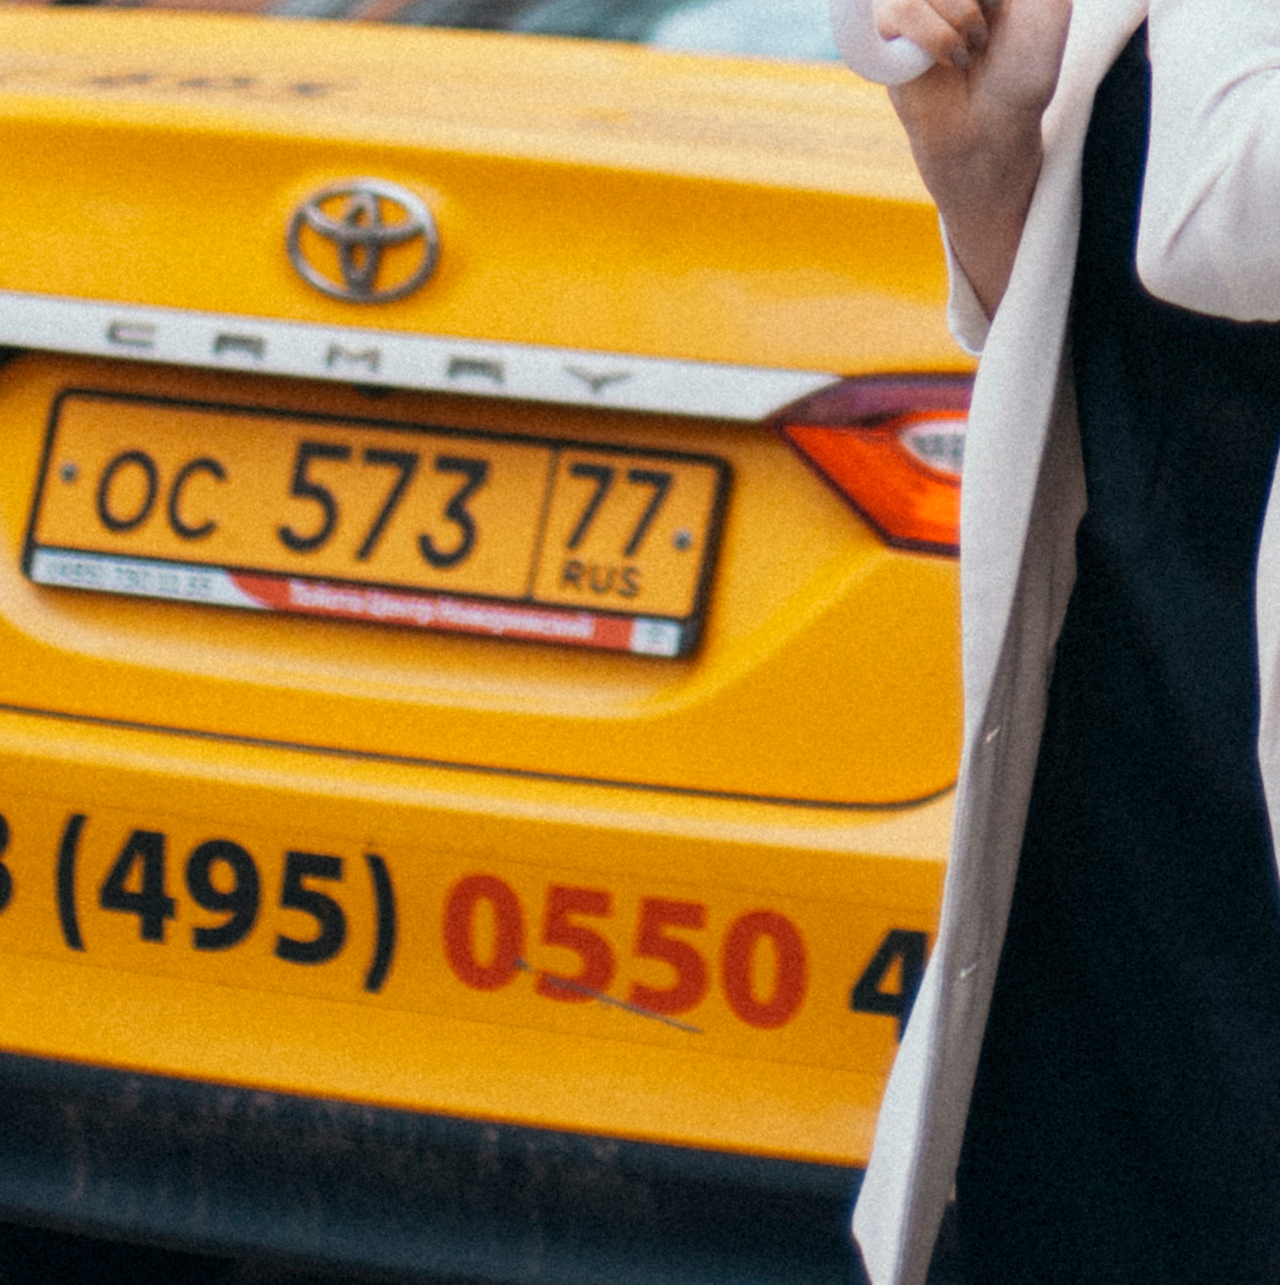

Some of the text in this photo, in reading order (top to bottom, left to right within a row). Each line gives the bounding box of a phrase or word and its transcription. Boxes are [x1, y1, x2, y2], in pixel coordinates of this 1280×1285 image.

[105, 319, 632, 394] CAMRY
[277, 442, 492, 568] 573
[566, 463, 674, 558] 77
[561, 561, 643, 600] RUS
[56, 813, 397, 994] (495)
[442, 872, 809, 1031] 0550
